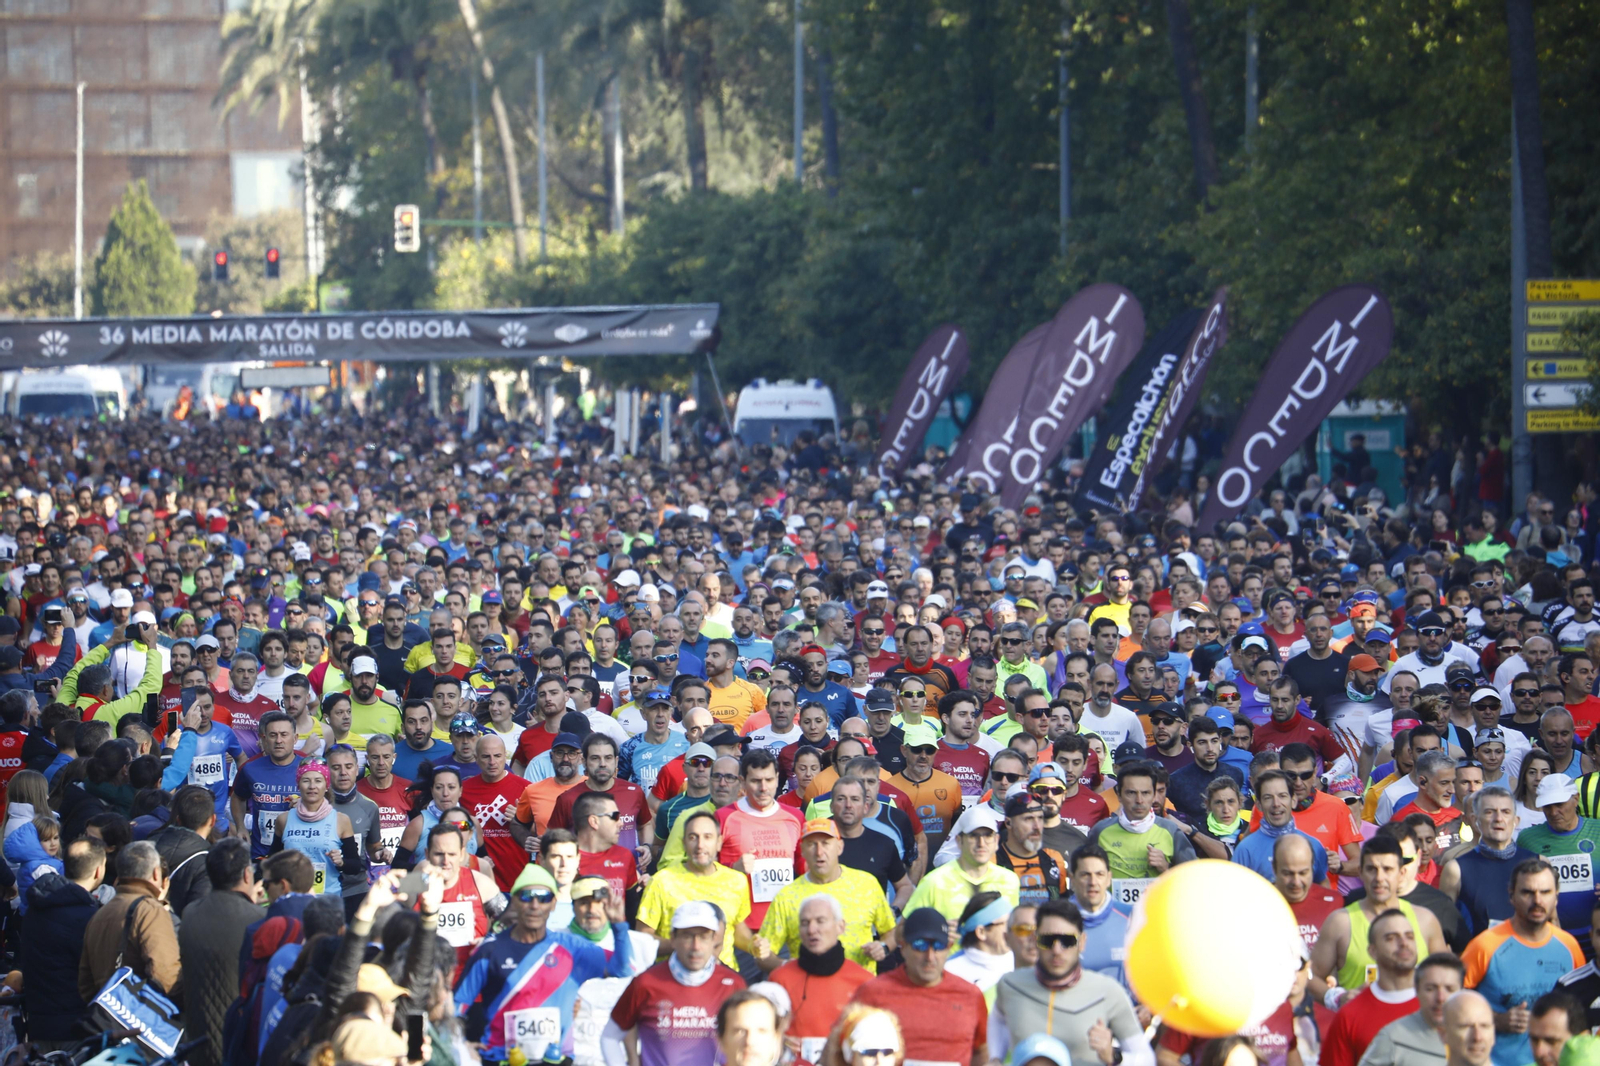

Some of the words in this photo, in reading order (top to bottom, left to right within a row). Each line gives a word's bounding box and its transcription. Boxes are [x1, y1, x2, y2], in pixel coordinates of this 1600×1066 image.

[99, 325, 125, 345] 36
[132, 324, 203, 344] MEDIA
[209, 319, 321, 343] MARATÓN
[327, 321, 355, 340] DE
[360, 317, 472, 339] CÓRDOBA
[259, 342, 316, 357] SALIDA
[1010, 293, 1128, 485] IMDECO
[1216, 295, 1379, 508] IMDECO
[1099, 352, 1178, 490] Especolchón
[0, 757, 22, 768] UCO
[195, 761, 222, 775] 4866
[953, 766, 975, 774] MEDIA
[266, 784, 300, 793] INFINI
[287, 827, 321, 839] nerja
[761, 868, 791, 883] 3002
[438, 912, 466, 927] 996
[672, 1006, 708, 1018] MEDIA
